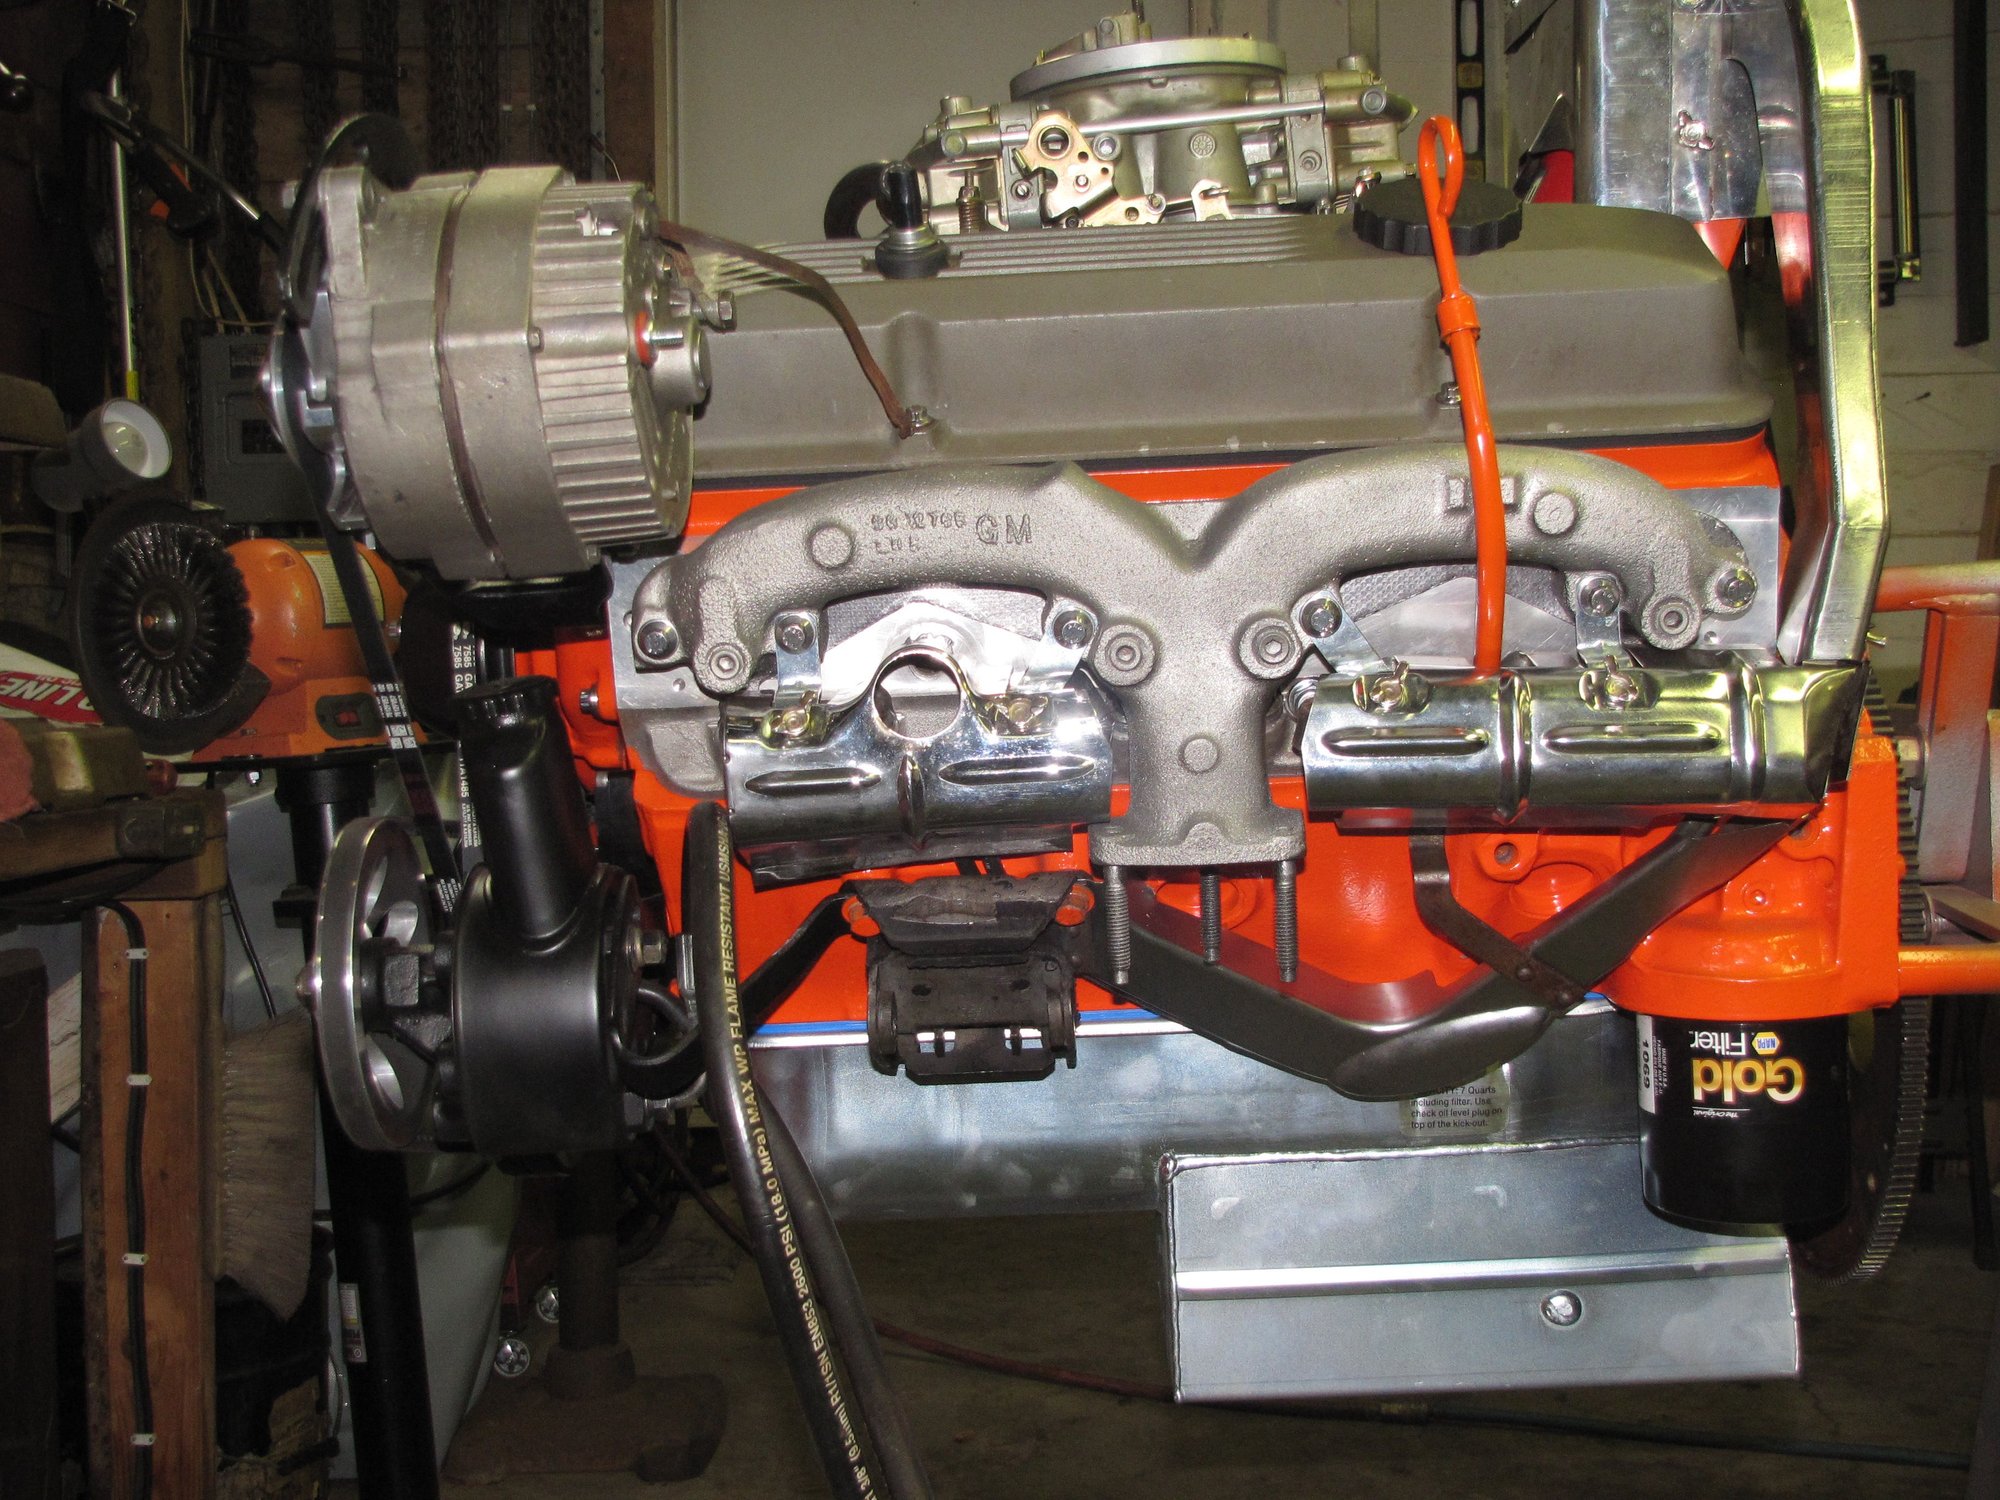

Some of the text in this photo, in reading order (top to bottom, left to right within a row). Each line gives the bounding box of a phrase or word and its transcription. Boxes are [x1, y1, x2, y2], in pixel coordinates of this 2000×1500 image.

[976, 513, 1032, 545] GM
[454, 646, 463, 669] 7585
[464, 645, 473, 668] 7585
[718, 883, 735, 974] RESISTANT
[724, 977, 743, 1040] FLAME
[1690, 1031, 1746, 1056] Filter
[1757, 1038, 1776, 1049] NAPA
[733, 1045, 749, 1078] WP
[1642, 1040, 1650, 1088] 1069
[1460, 1086, 1466, 1094] 7
[1468, 1085, 1496, 1095] Quarts
[1692, 1058, 1803, 1103] Gold
[741, 1079, 759, 1127] MAX
[1411, 1109, 1436, 1118] check
[1438, 1109, 1449, 1117] oil
[1450, 1108, 1470, 1117] level
[1471, 1107, 1490, 1118] plug
[1451, 1098, 1473, 1106] filter.
[1474, 1098, 1491, 1106] Use
[1411, 1121, 1425, 1130] top
[1427, 1120, 1436, 1128] of
[1436, 1119, 1451, 1128] the
[752, 1127, 774, 1174] MPa)
[766, 1177, 788, 1222] (18.0
[779, 1223, 796, 1257] PSI
[790, 1256, 809, 1298] 2600
[802, 1298, 825, 1351] EN853
[853, 1464, 872, 1492] 3/8"
